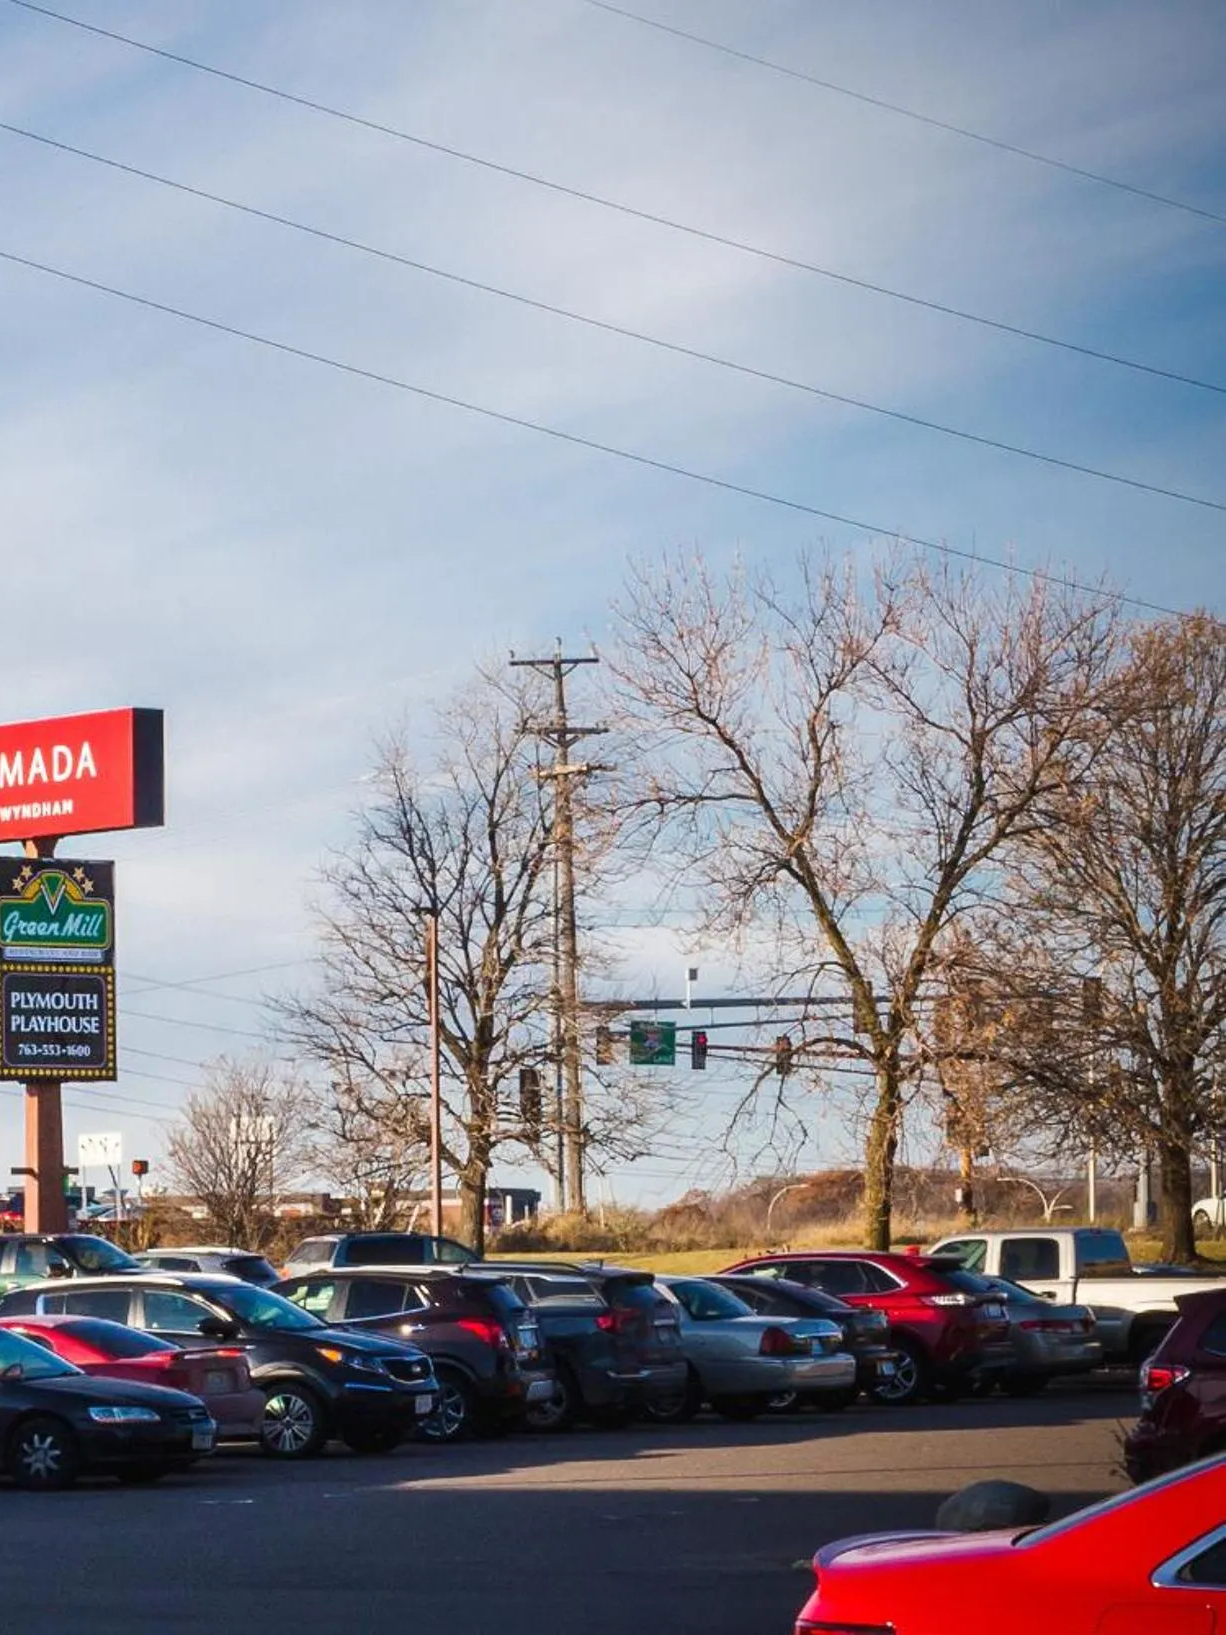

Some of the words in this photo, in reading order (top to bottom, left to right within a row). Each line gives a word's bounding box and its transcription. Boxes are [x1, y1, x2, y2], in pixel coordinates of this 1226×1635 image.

[0, 799, 74, 822] WYNDHAM
[3, 911, 60, 942] Green
[61, 913, 104, 937] Mill
[10, 991, 99, 1010] PLYMOUTH
[10, 1014, 101, 1034] PLAYHOUSE
